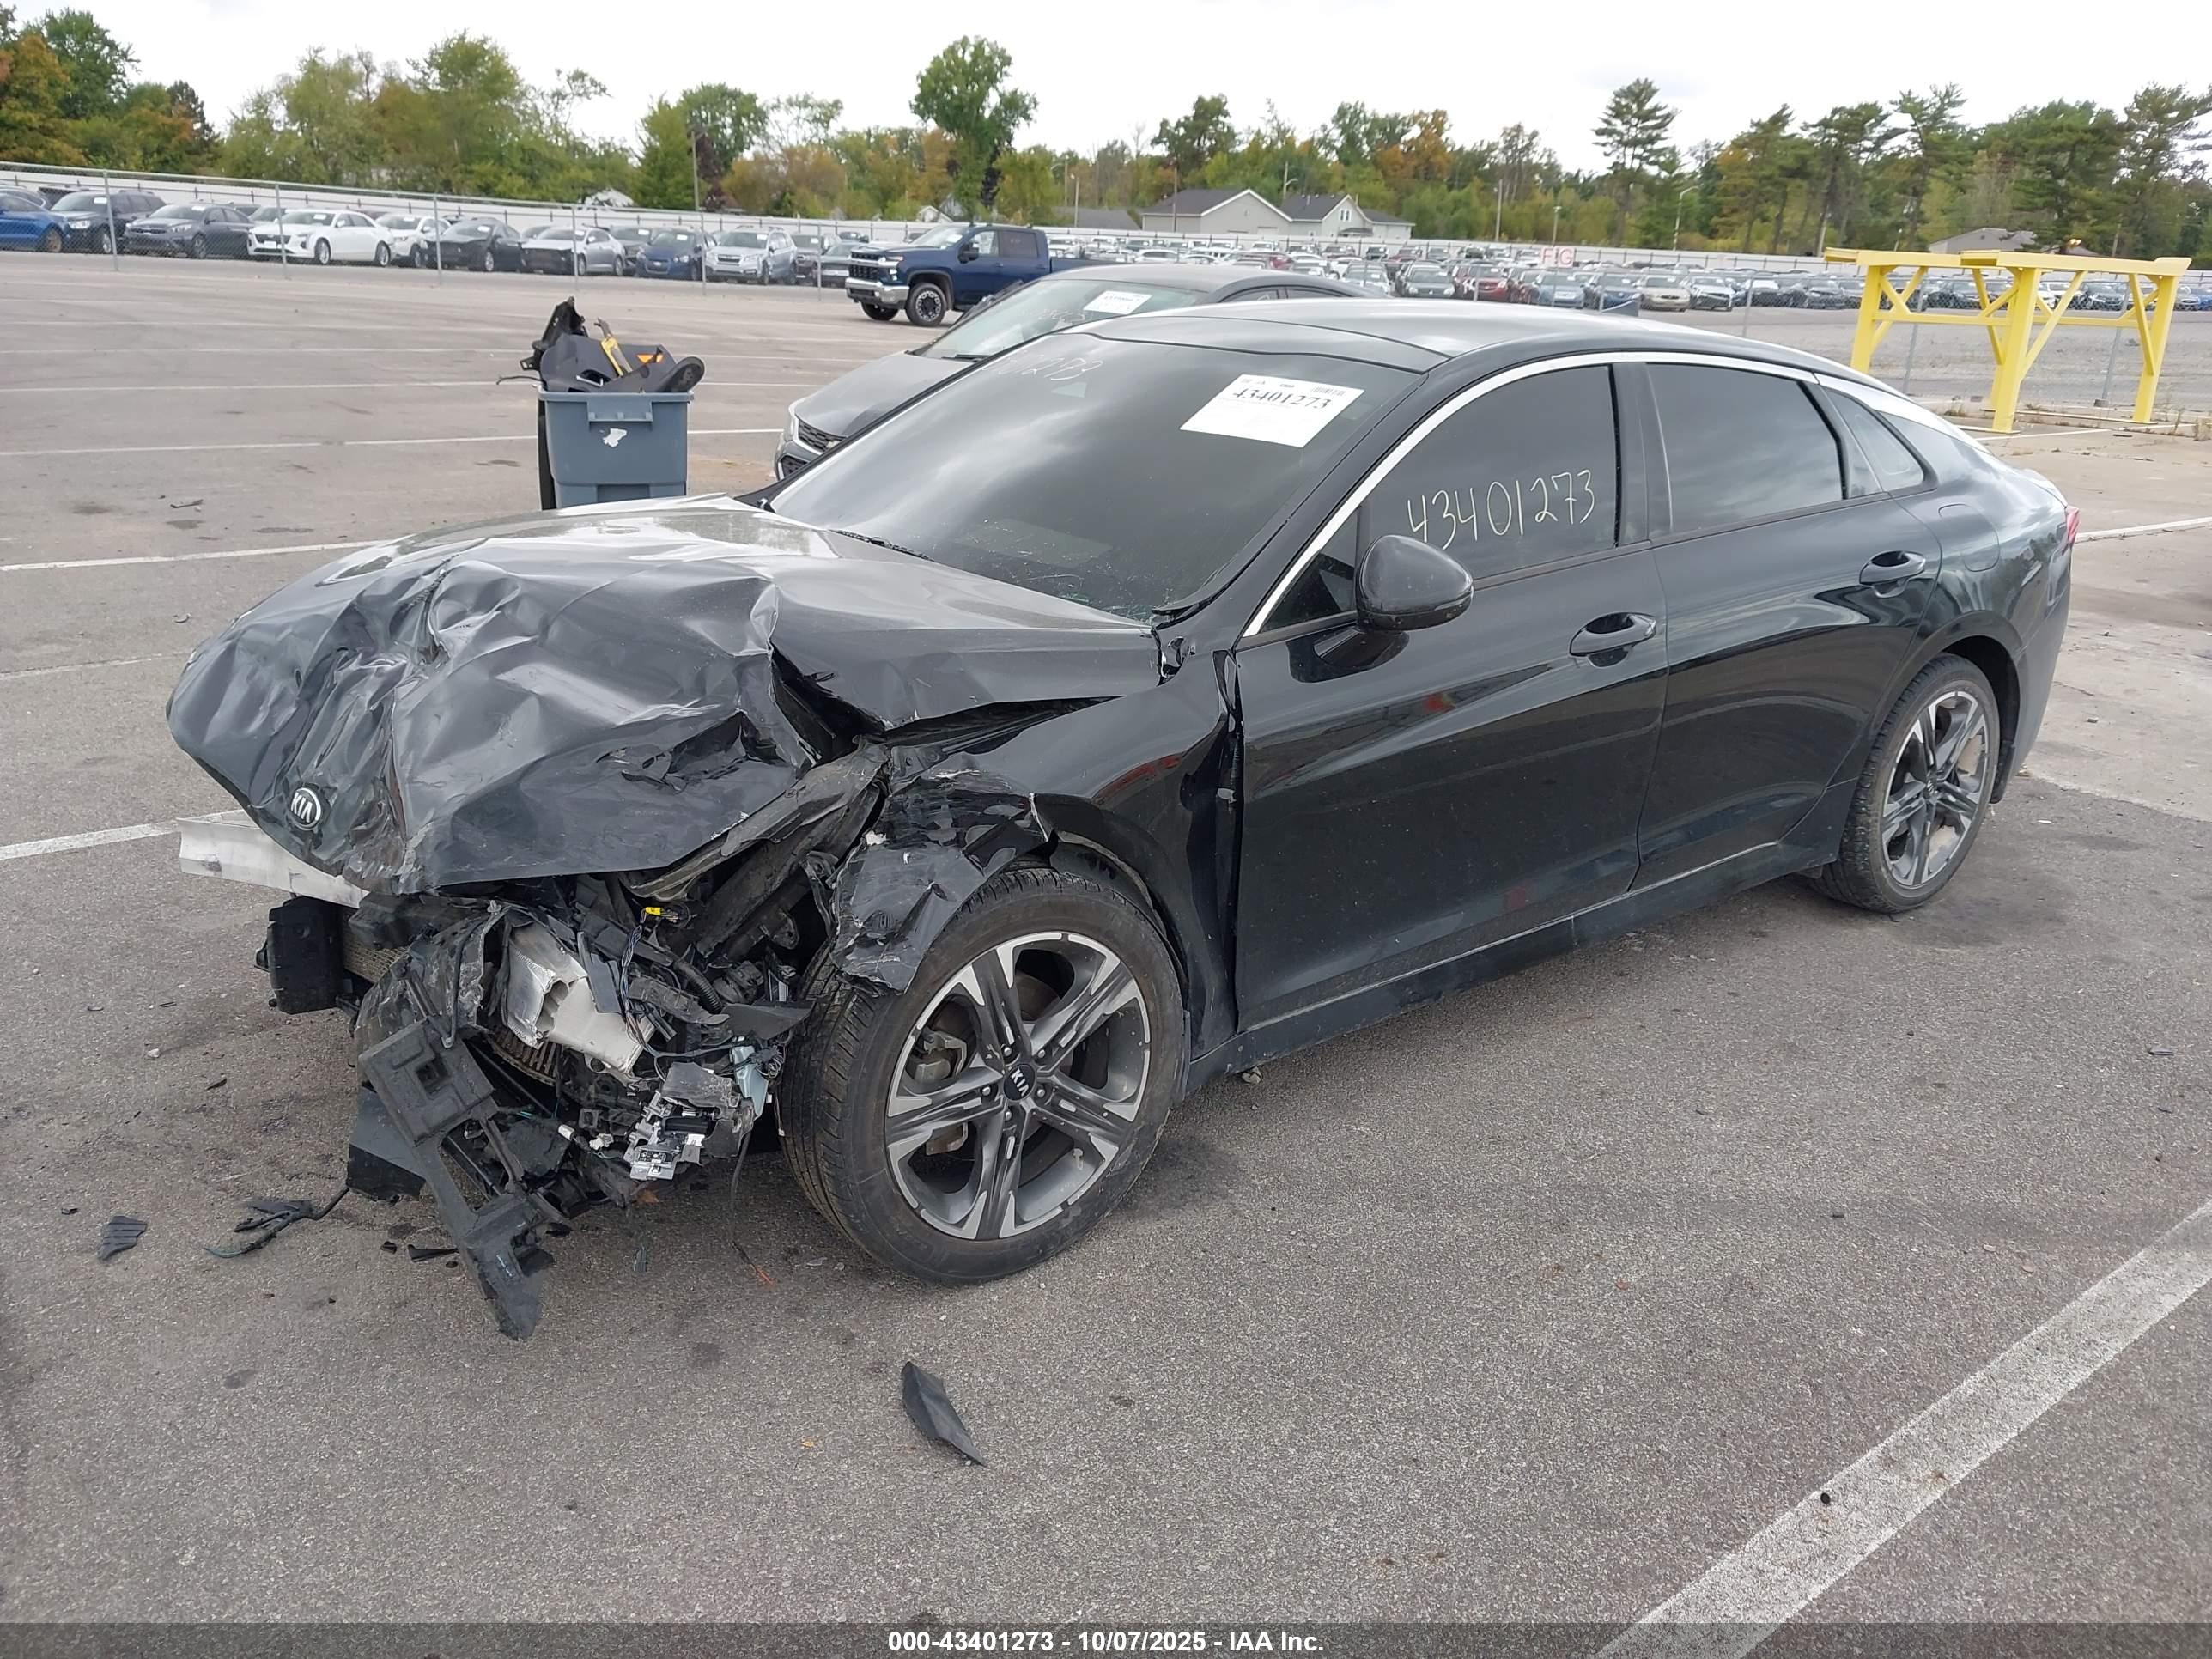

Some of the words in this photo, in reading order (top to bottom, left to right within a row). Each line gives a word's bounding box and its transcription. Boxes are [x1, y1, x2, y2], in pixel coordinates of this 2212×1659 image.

[1559, 247, 1573, 266] G
[1232, 387, 1332, 410] 43401273
[1407, 469, 1595, 550] 43401273
[1011, 1066, 1030, 1097] KIA
